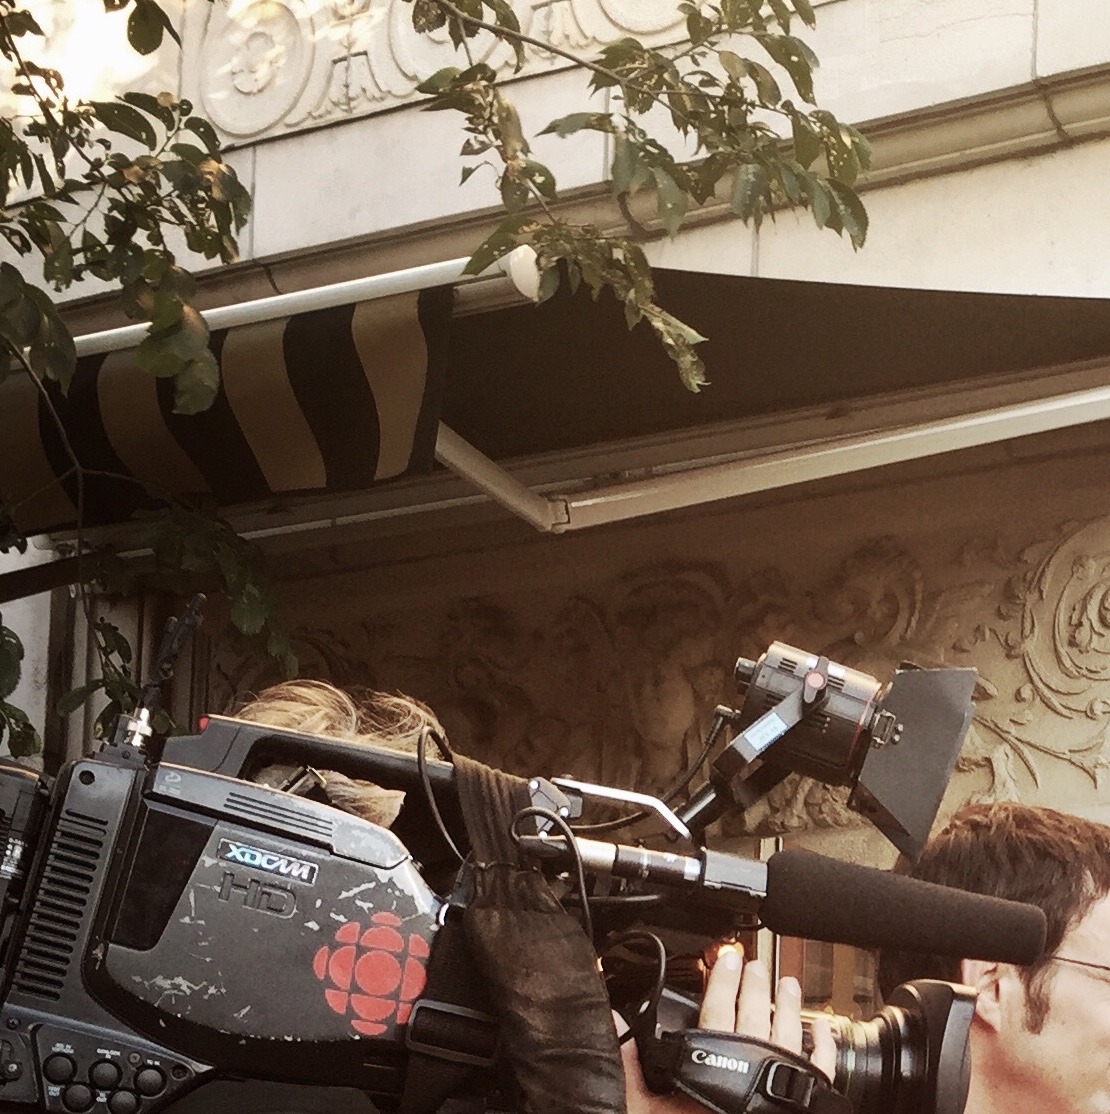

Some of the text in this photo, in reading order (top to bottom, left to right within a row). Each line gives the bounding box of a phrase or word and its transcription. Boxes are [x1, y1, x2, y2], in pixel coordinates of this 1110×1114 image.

[225, 843, 311, 880] XDCAM
[218, 871, 298, 919] HD
[690, 1048, 750, 1075] Canon
